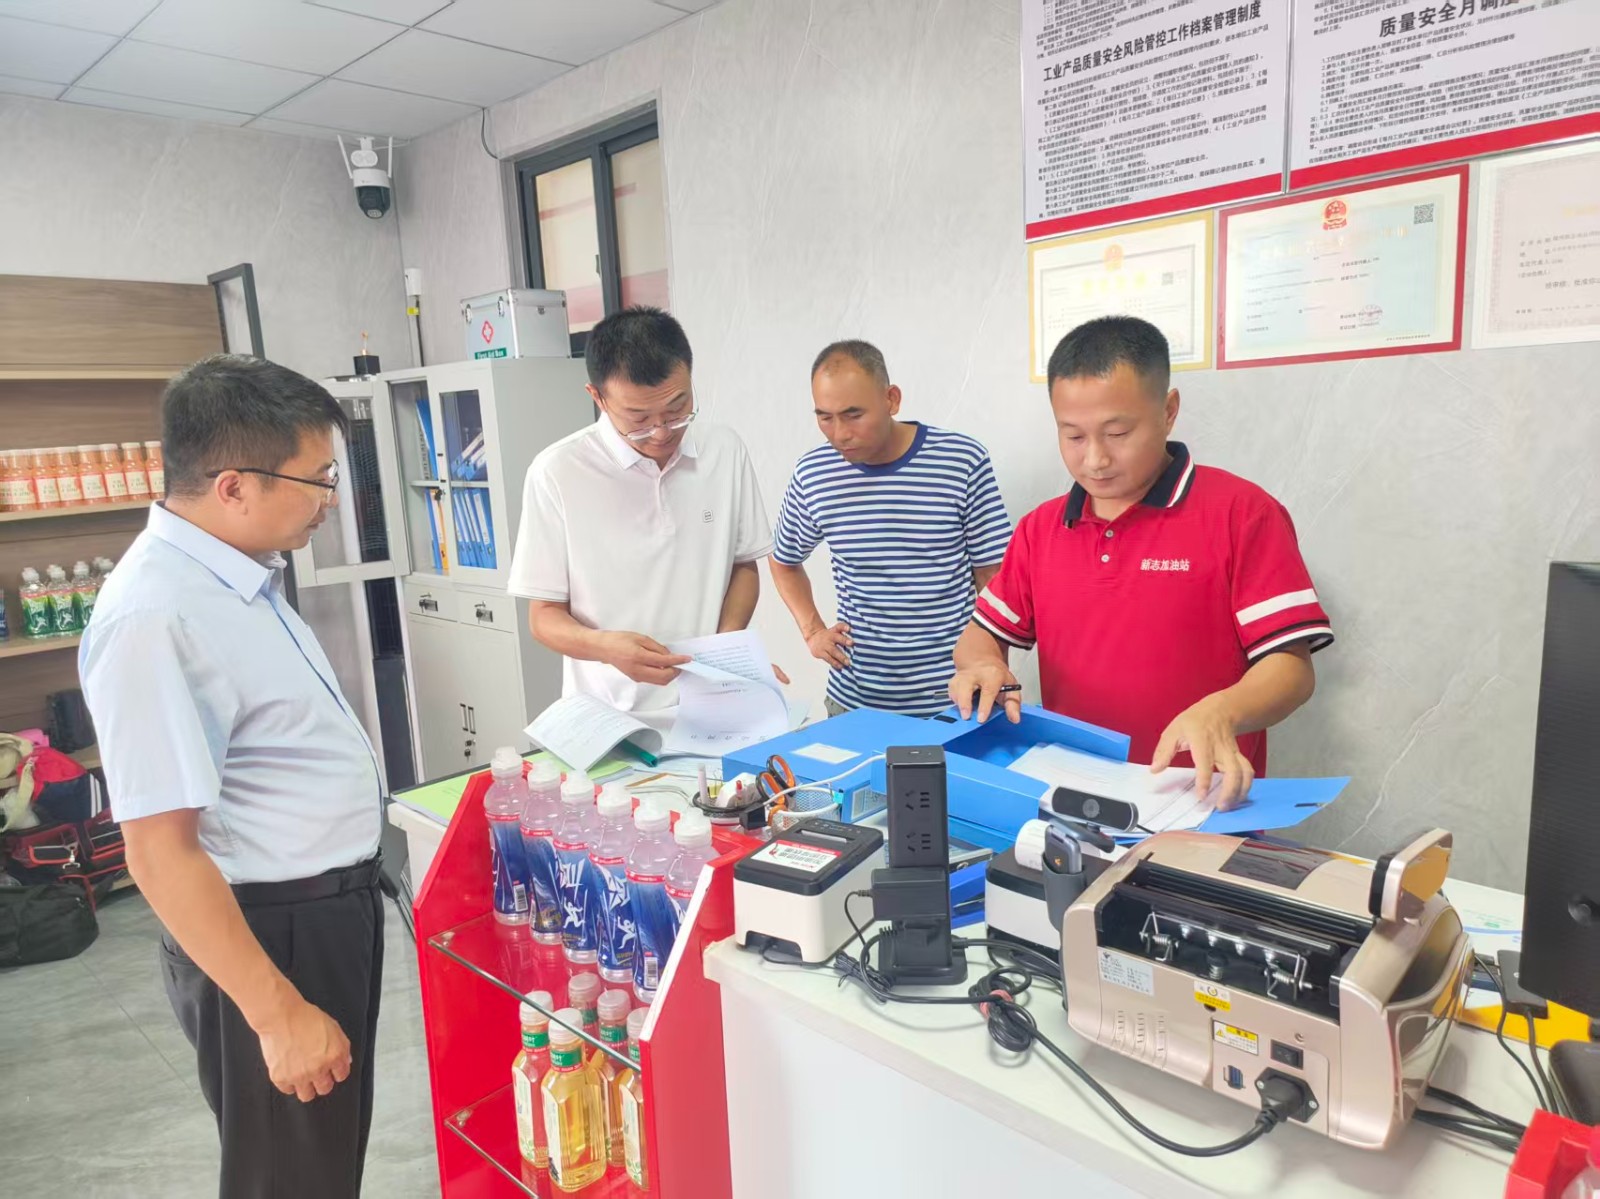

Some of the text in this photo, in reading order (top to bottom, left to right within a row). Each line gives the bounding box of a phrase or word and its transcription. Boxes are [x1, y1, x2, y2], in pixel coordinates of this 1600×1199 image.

[1043, 0, 1261, 81] 工业产品质量安全风险管控工作档案管理制度
[1141, 558, 1190, 571] 新志加油站
